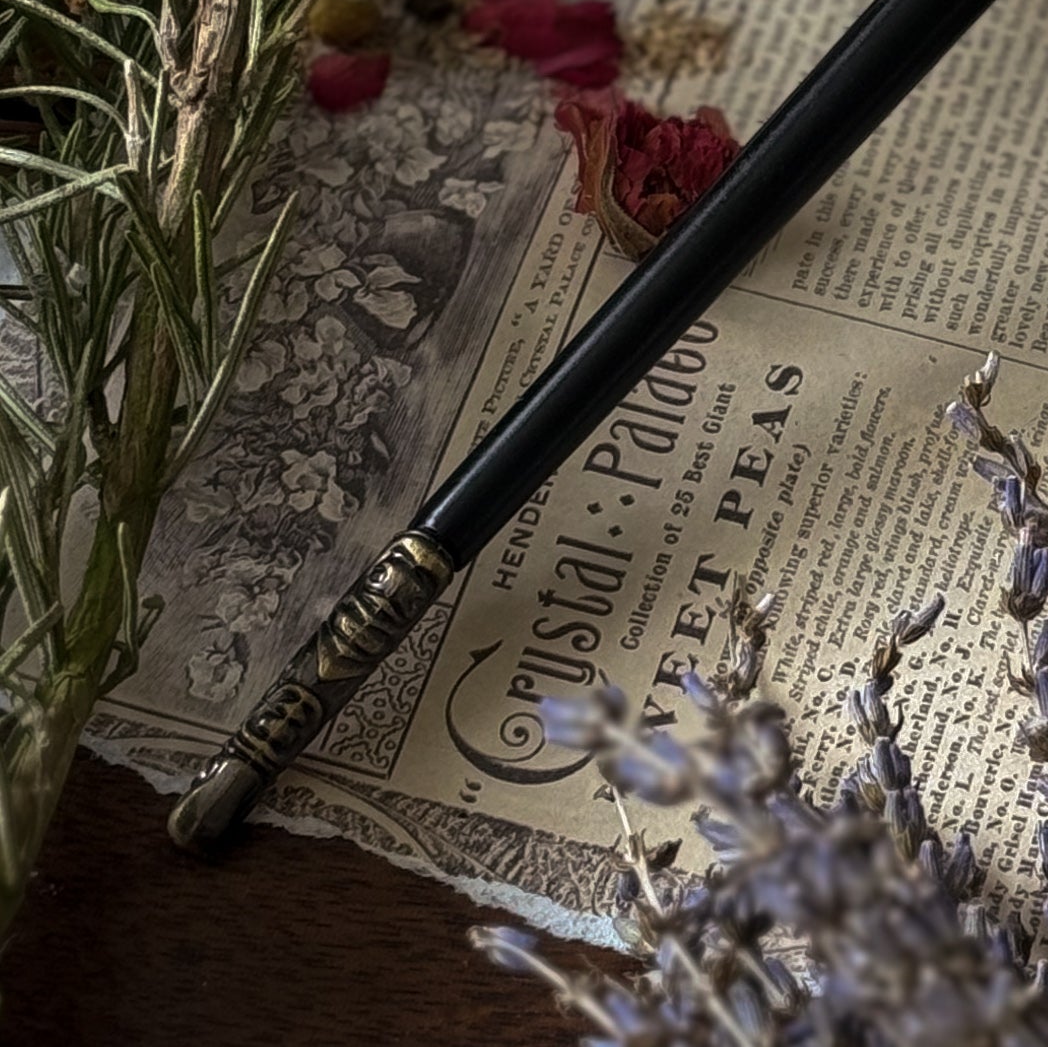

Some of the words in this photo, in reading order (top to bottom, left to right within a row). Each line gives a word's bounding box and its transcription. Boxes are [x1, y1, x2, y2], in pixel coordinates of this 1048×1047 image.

[530, 232, 565, 290] YARD
[813, 234, 848, 297] success,
[833, 258, 861, 301] there
[852, 207, 880, 253] made
[857, 223, 898, 309] experience
[901, 260, 935, 321] prising
[935, 177, 961, 228] colors
[923, 259, 957, 323] without
[947, 158, 994, 251] duplicating
[945, 293, 969, 332] such
[959, 211, 997, 285] favorites
[968, 240, 1012, 335] wonderfully
[990, 279, 1020, 344] greater
[1013, 202, 1048, 275] quantity
[878, 275, 902, 312] with
[1008, 296, 1042, 349] lovely
[701, 383, 736, 434] Giant
[715, 365, 803, 528] PEAS
[797, 462, 834, 540] superior
[827, 372, 867, 455] varieties:
[670, 489, 695, 518] 25
[682, 441, 714, 484] Best
[663, 522, 683, 545] of
[741, 511, 784, 595] opposite
[777, 443, 812, 506] plate)
[771, 633, 804, 684] White,
[795, 569, 824, 630] striped
[827, 484, 858, 529] large,
[844, 444, 870, 481] bold
[860, 387, 892, 445] flowers.
[788, 638, 821, 703] Striped
[813, 591, 841, 638] white,
[832, 529, 860, 587] orange
[853, 494, 873, 529] and
[866, 432, 897, 492] salmon.
[827, 600, 857, 649] Extra
[846, 553, 874, 598] large
[865, 503, 894, 554] glossy
[883, 433, 916, 501] maroon.
[853, 601, 881, 642] Rosy
[883, 516, 908, 563] wings
[897, 468, 928, 515] blush,
[886, 565, 912, 615] claret
[904, 529, 925, 564] and
[915, 490, 942, 527] lake,
[909, 534, 948, 612] standard,
[938, 481, 963, 531] cream
[934, 511, 975, 592] heliotrope.
[956, 516, 994, 593] Exquisite
[620, 552, 672, 651] Collection
